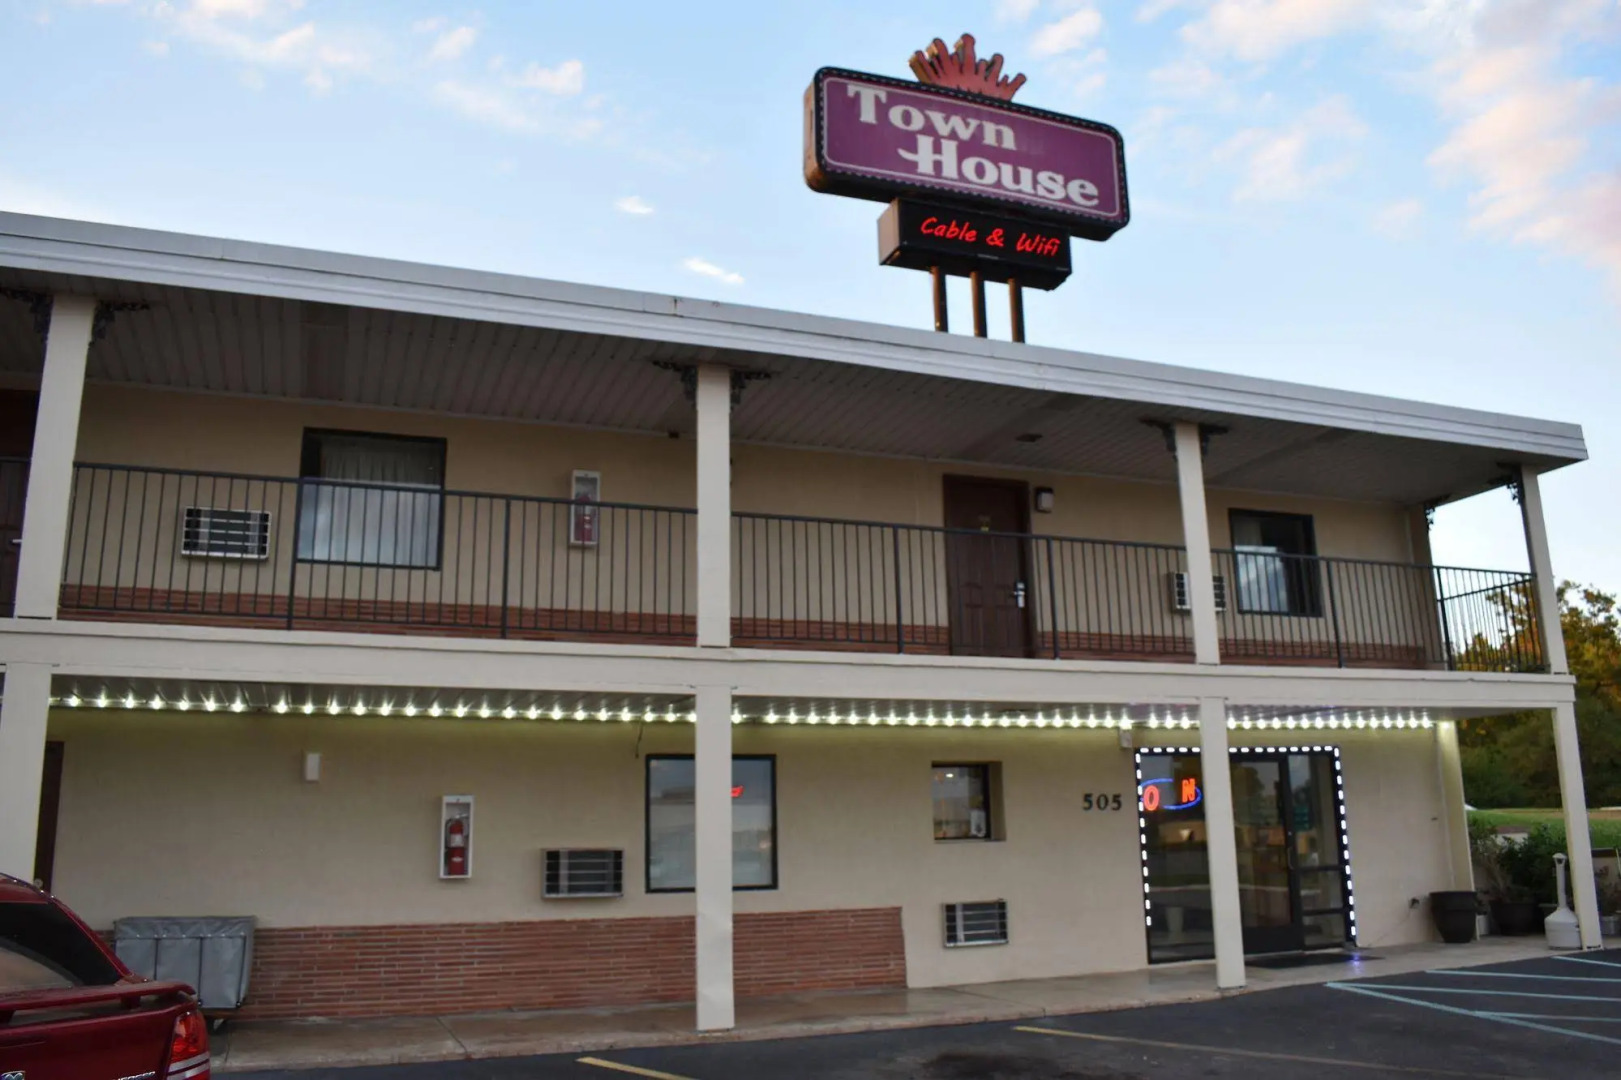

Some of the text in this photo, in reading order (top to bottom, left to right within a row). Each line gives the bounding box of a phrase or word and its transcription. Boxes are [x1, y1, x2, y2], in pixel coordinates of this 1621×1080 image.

[847, 84, 1017, 150] Town
[897, 134, 1099, 206] House
[920, 216, 1061, 256] Cable & Wifi
[1082, 792, 1122, 811] 505
